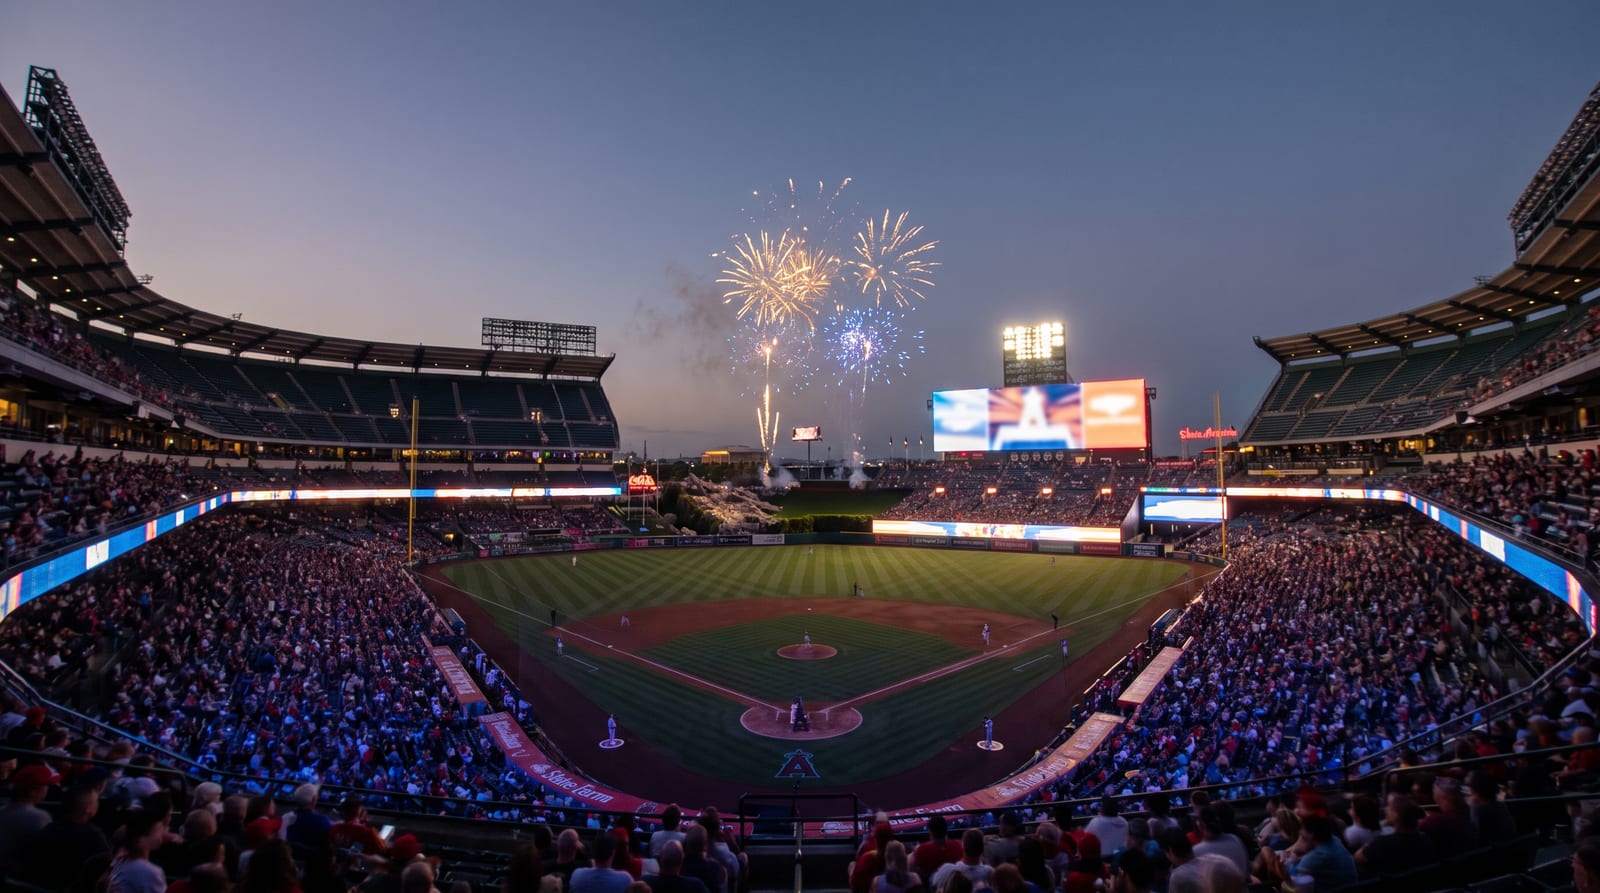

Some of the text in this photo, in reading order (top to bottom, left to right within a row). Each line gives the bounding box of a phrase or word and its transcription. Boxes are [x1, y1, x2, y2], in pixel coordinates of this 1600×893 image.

[774, 749, 821, 778] A
[542, 770, 614, 804] State Farm
